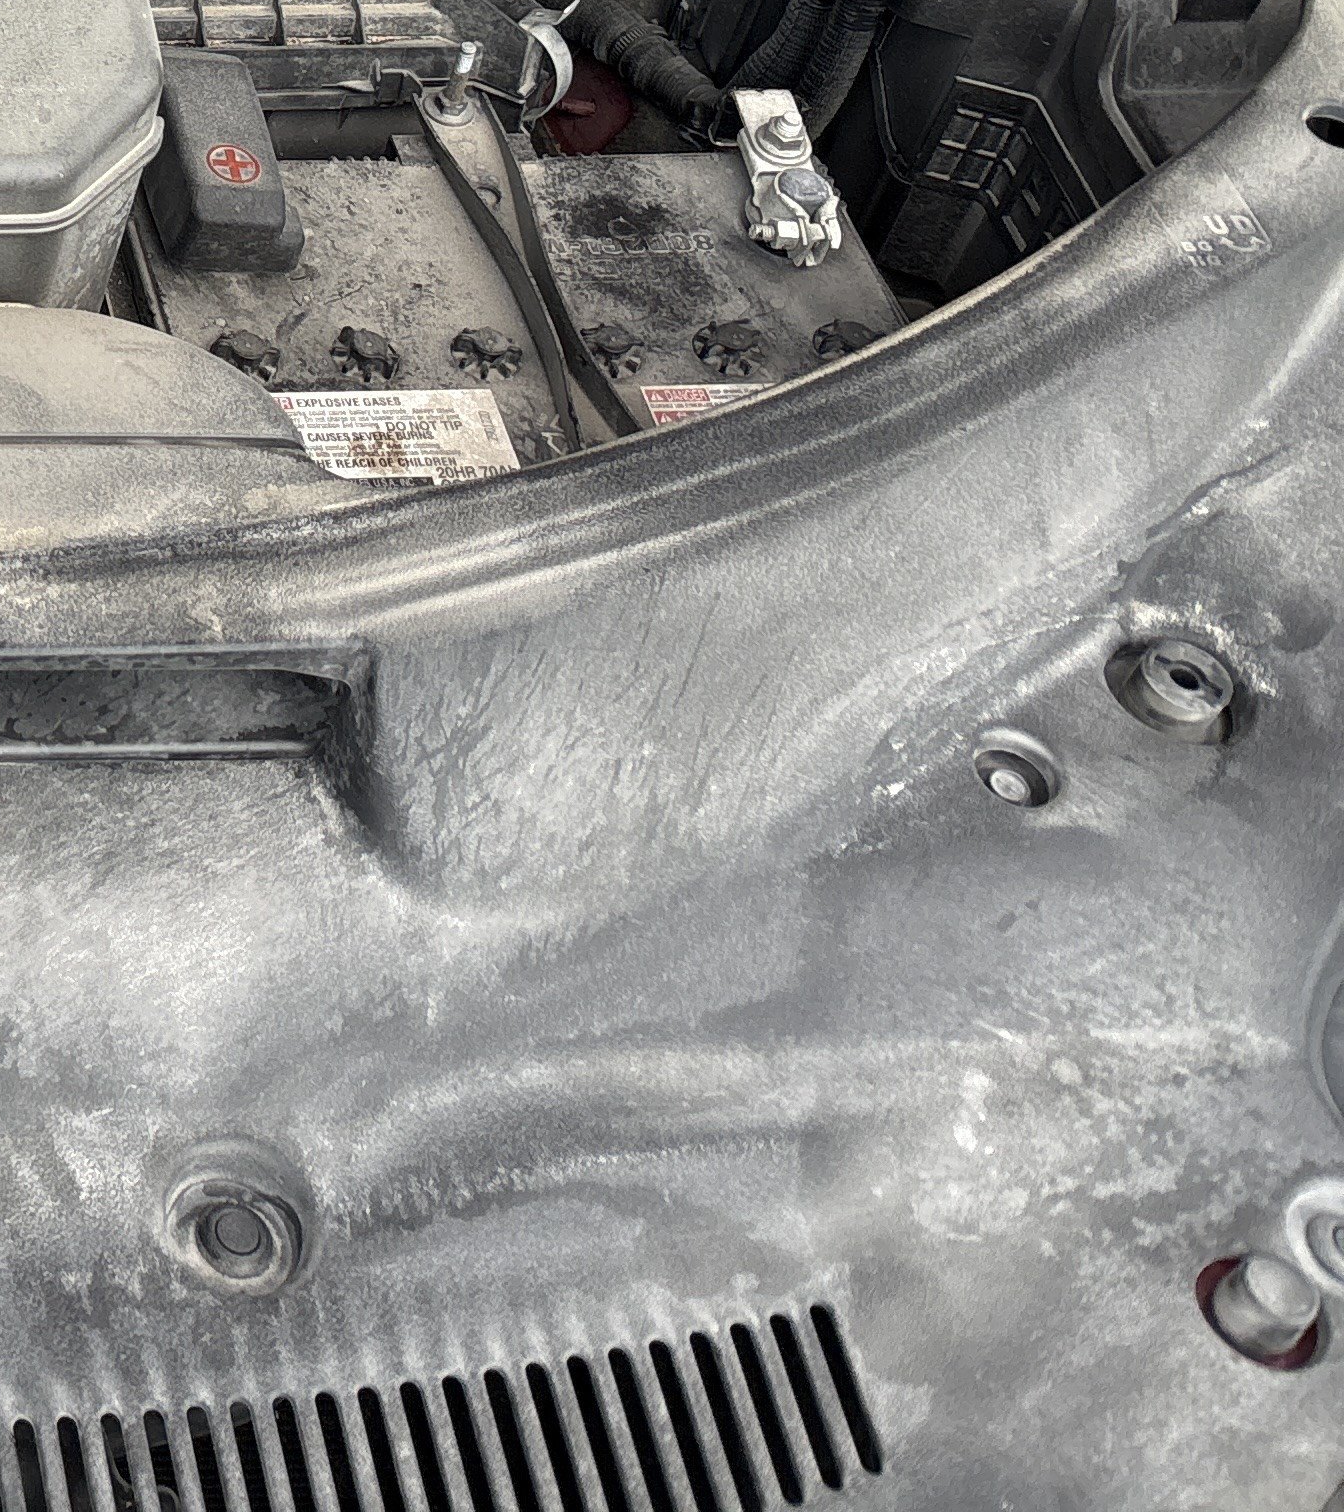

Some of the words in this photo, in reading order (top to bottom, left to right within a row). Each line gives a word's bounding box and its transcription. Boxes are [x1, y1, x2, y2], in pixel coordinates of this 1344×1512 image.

[663, 389, 708, 402] DANGER
[296, 397, 360, 407] EXPLOSIVE
[362, 396, 401, 406] GASES
[385, 421, 406, 431] DO
[409, 420, 436, 431] NOT
[440, 420, 463, 431] TIP
[307, 432, 350, 442] CAUSES
[352, 432, 393, 441] SEVERE
[395, 430, 434, 441] BURNS
[335, 458, 376, 468] REACH
[378, 458, 395, 468] OF
[397, 457, 457, 468] CHILDREN
[436, 466, 477, 479] 20HR
